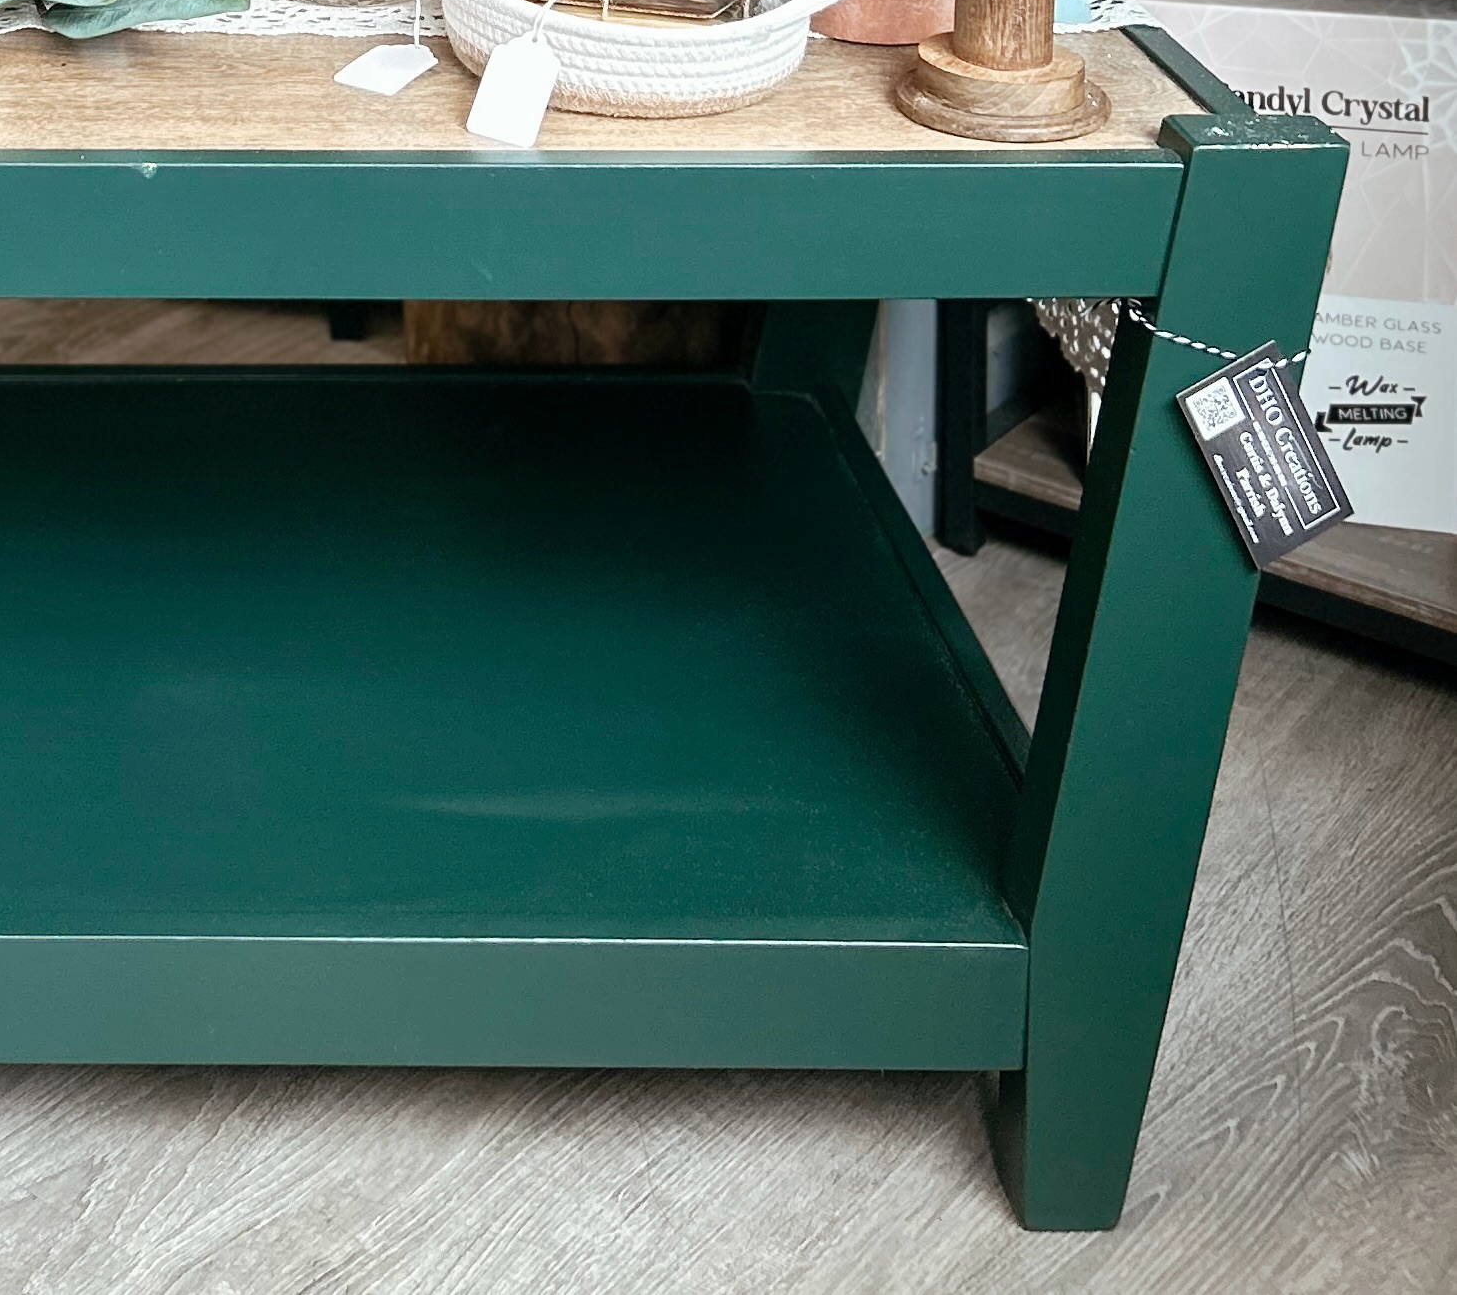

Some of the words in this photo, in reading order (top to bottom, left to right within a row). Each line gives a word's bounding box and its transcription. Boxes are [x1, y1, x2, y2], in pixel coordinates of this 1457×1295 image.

[1233, 86, 1311, 116] andyl
[1321, 89, 1430, 125] Crystal
[1361, 140, 1430, 160] LAMP
[1314, 312, 1377, 329] AMBER
[1383, 317, 1442, 335] GLASS
[1311, 332, 1373, 349] WOOD
[1380, 337, 1428, 354] BASE
[1345, 374, 1398, 397] Wax
[1338, 407, 1408, 420] MELTING
[1249, 376, 1284, 426] DHO
[1275, 427, 1324, 515] Creations
[1342, 427, 1393, 453] Lamp
[1239, 432, 1264, 474] Curtis
[1236, 467, 1267, 518] Parrish
